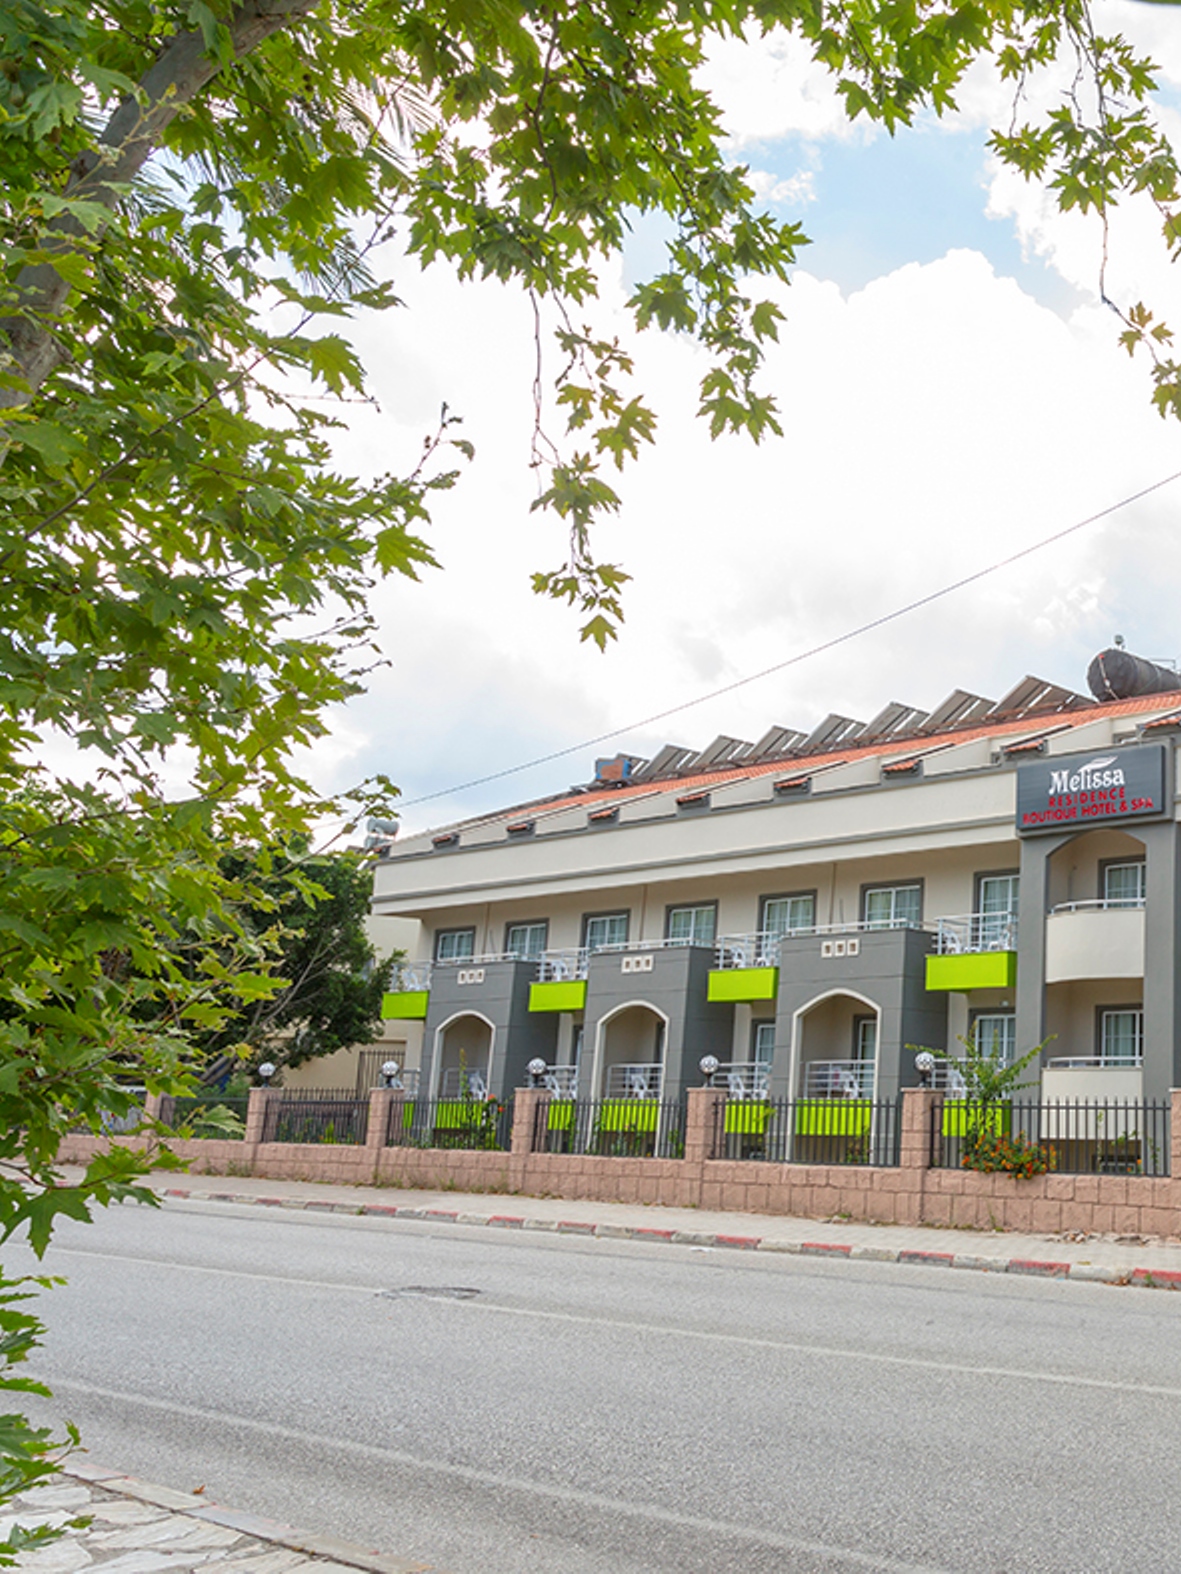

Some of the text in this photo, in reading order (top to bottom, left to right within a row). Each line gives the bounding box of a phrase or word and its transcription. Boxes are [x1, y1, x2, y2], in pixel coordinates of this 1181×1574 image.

[1049, 768, 1125, 794] Melissa
[1048, 787, 1125, 808] RESIDENCE
[1022, 797, 1154, 825] BOUTIQUE HOTEL & SPA
